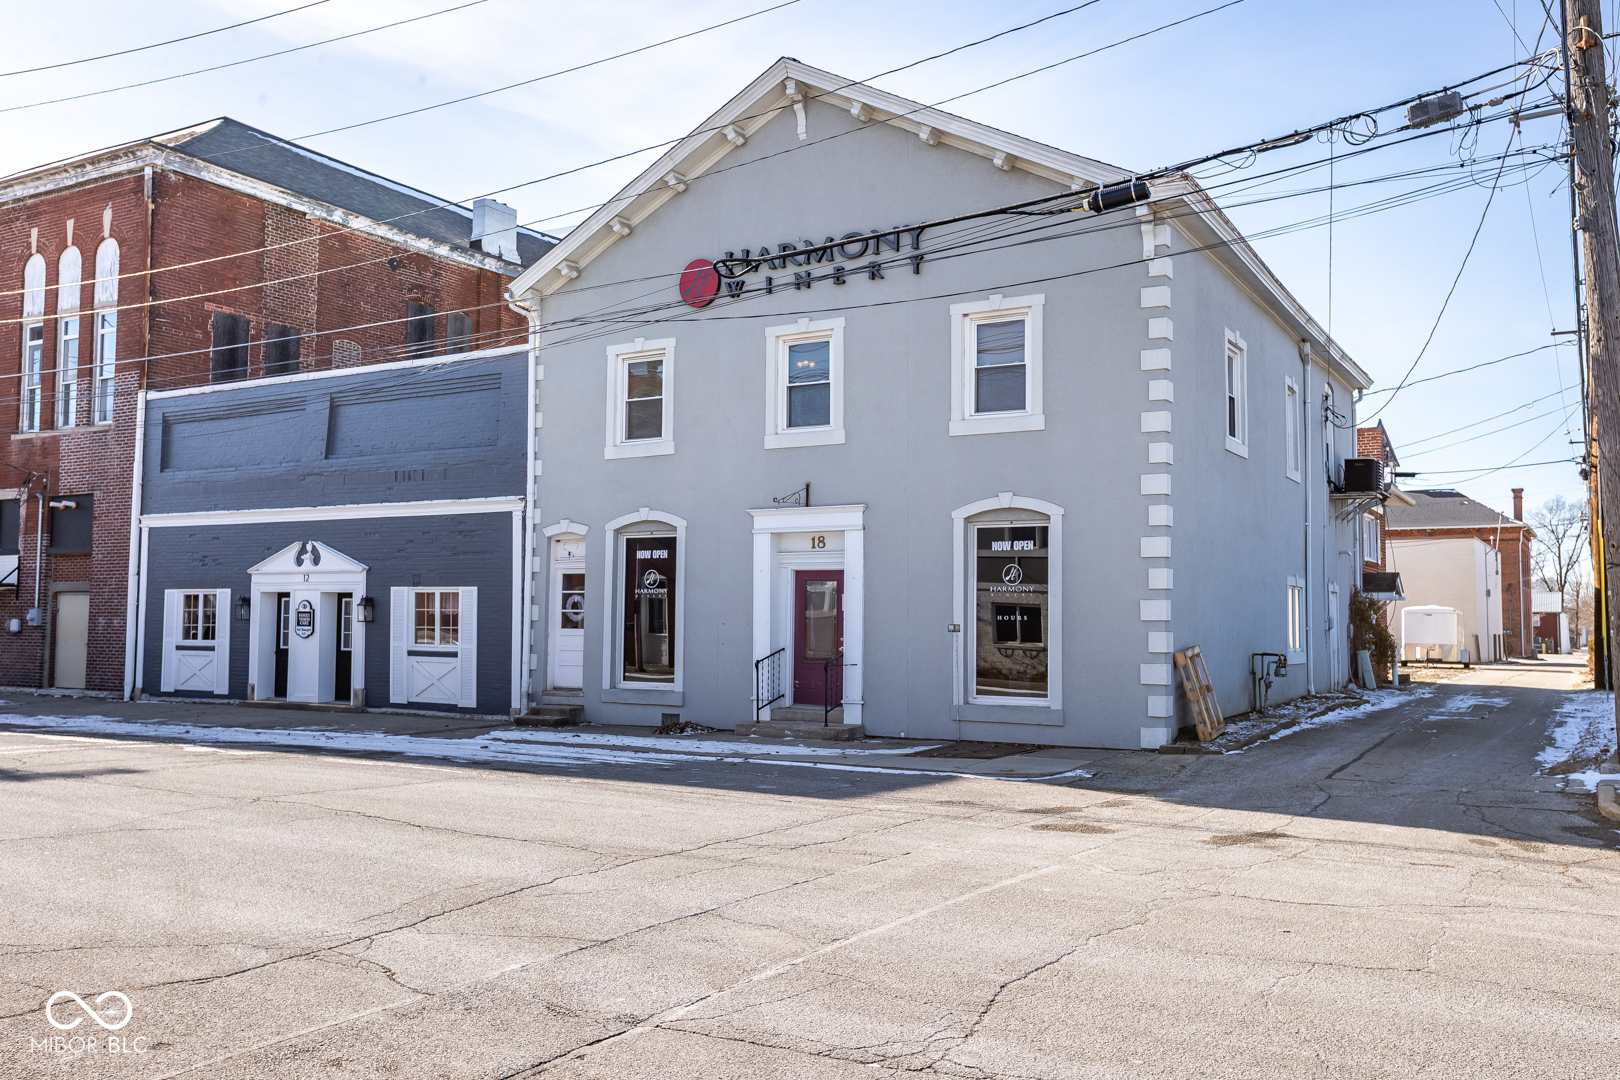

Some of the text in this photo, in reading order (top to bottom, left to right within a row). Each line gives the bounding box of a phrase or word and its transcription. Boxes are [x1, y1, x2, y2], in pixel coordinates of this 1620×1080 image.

[724, 221, 927, 276] HARMONY
[724, 255, 924, 298] WINERY
[811, 535, 826, 549] 18
[991, 540, 1034, 551] NOW OPEN
[636, 550, 668, 559] NOW OPEN
[303, 574, 310, 582] 12
